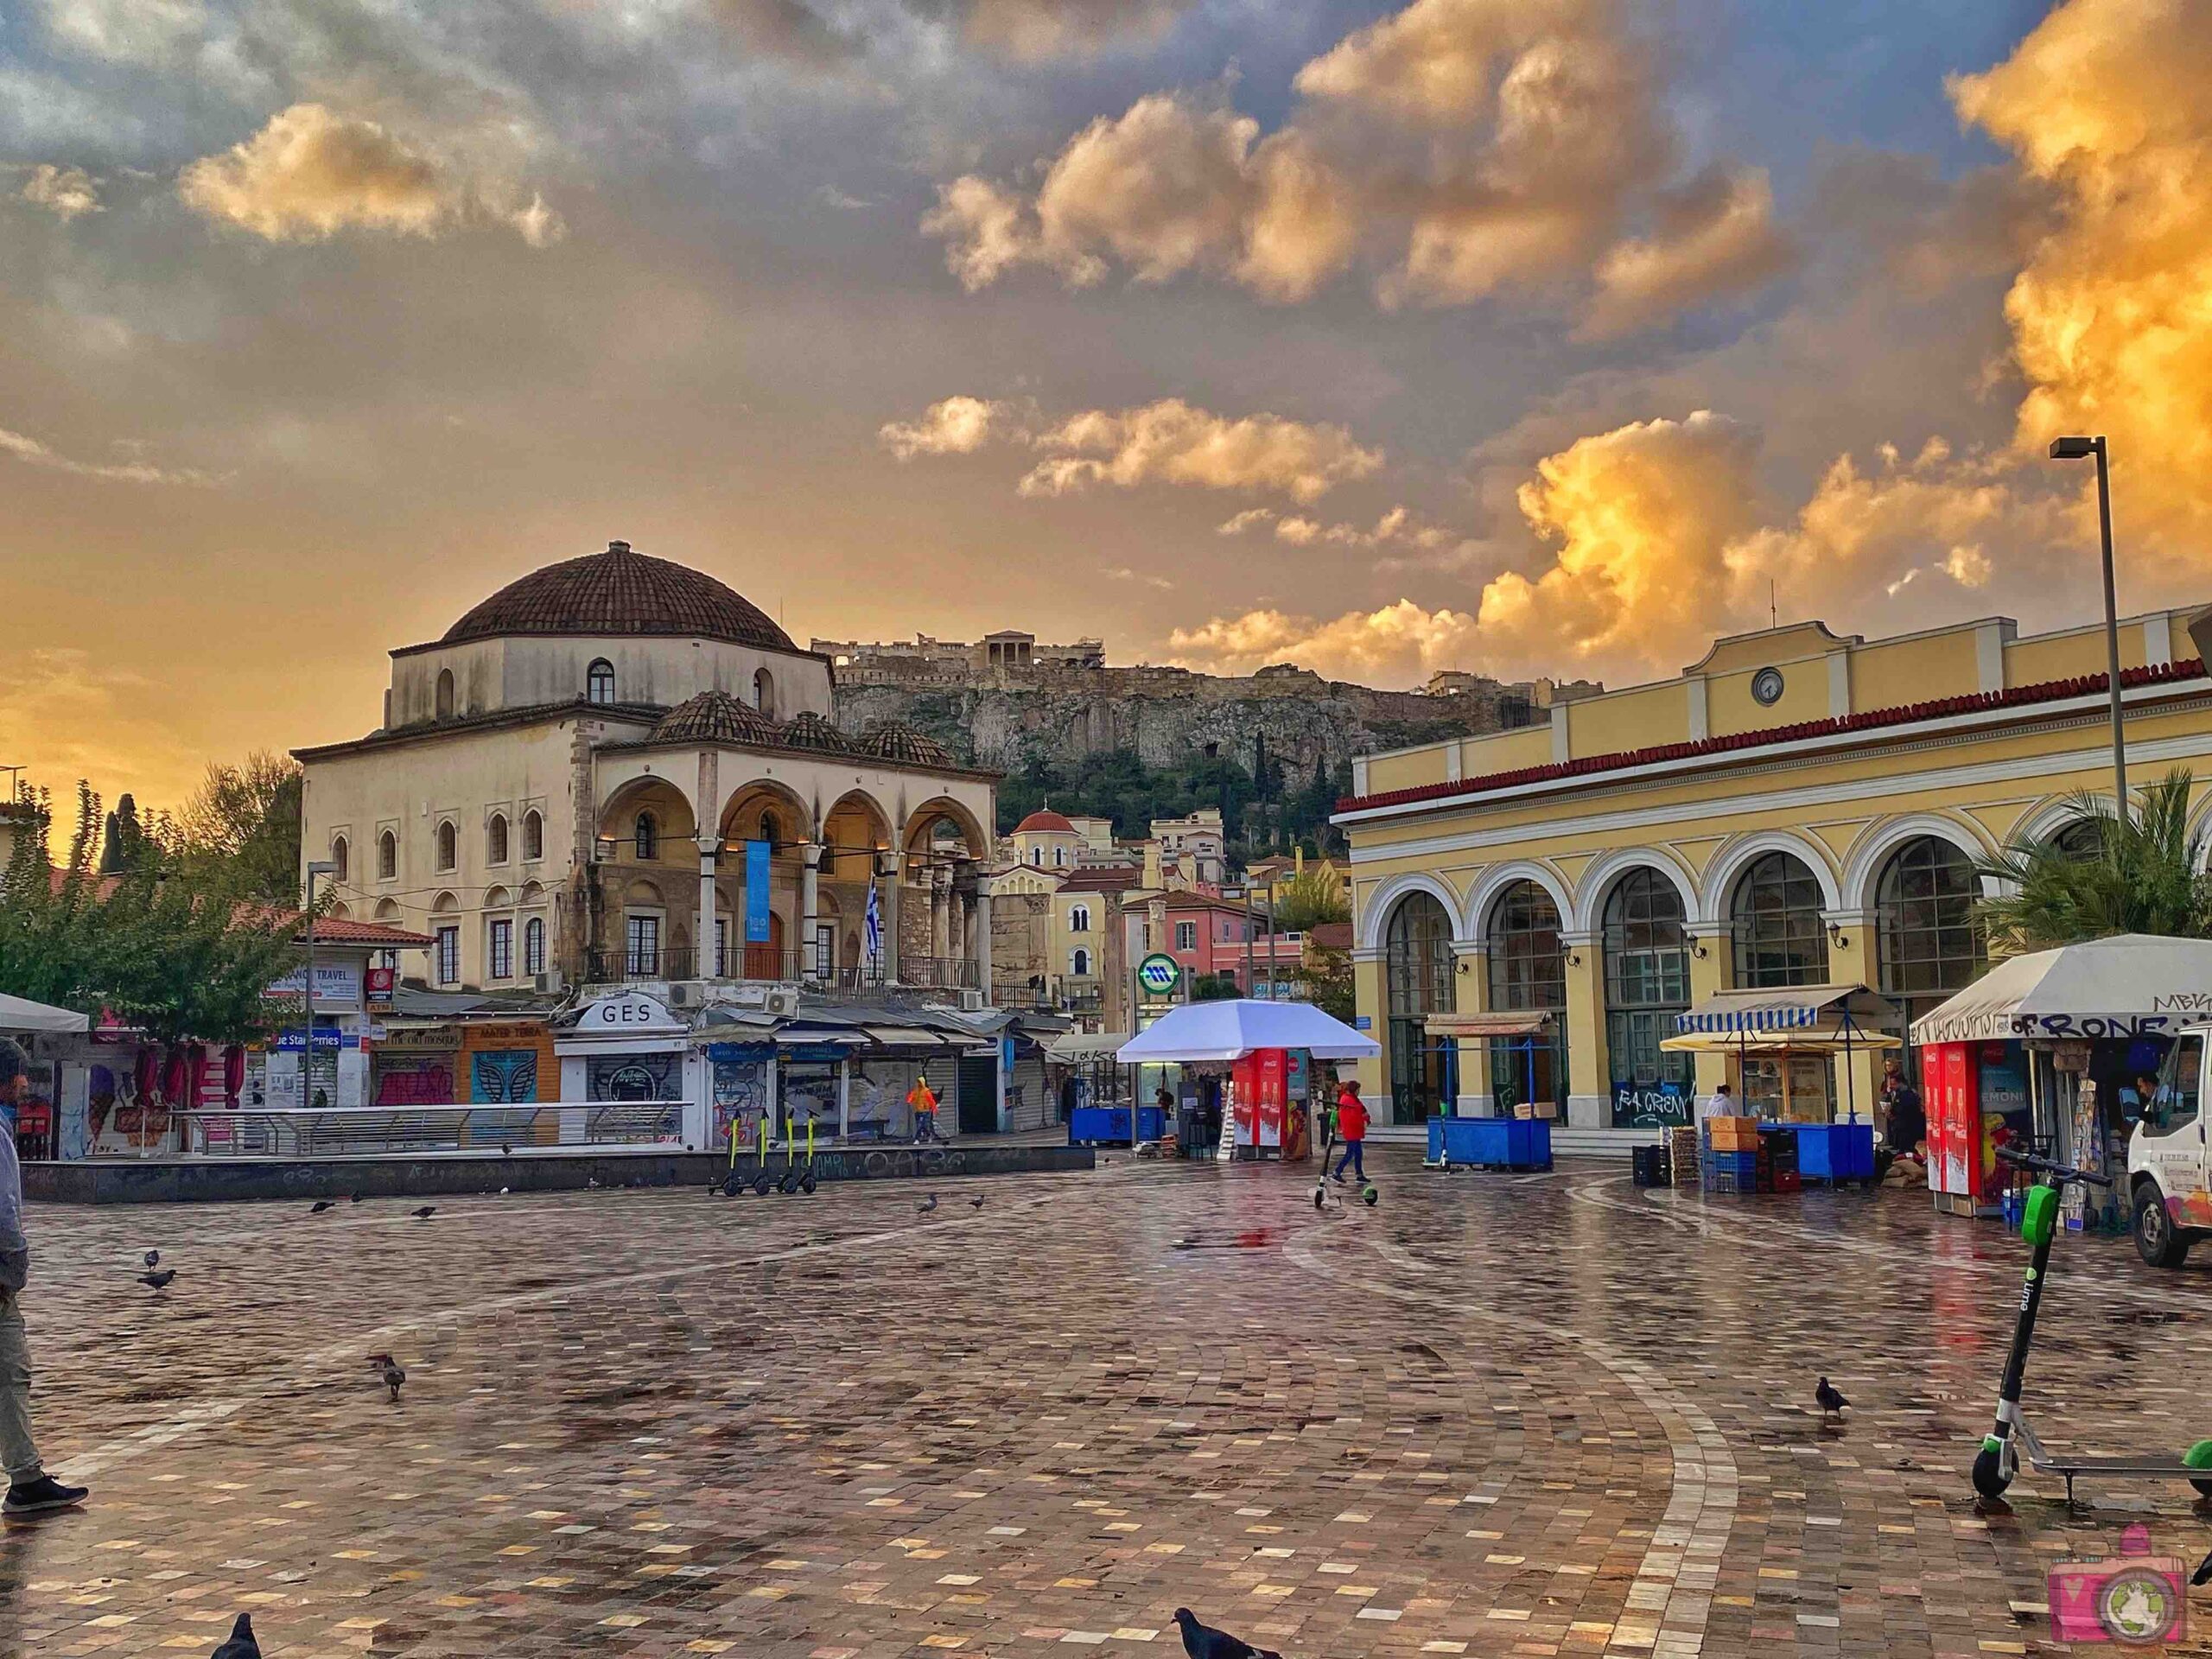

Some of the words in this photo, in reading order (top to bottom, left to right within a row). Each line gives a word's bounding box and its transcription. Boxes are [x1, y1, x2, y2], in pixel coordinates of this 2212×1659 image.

[316, 969, 347, 981] TRAVEL
[602, 1004, 651, 1022] GES
[407, 1033, 422, 1046] old
[1981, 1090, 2024, 1103] EMONI
[2019, 1282, 2034, 1312] Lime
